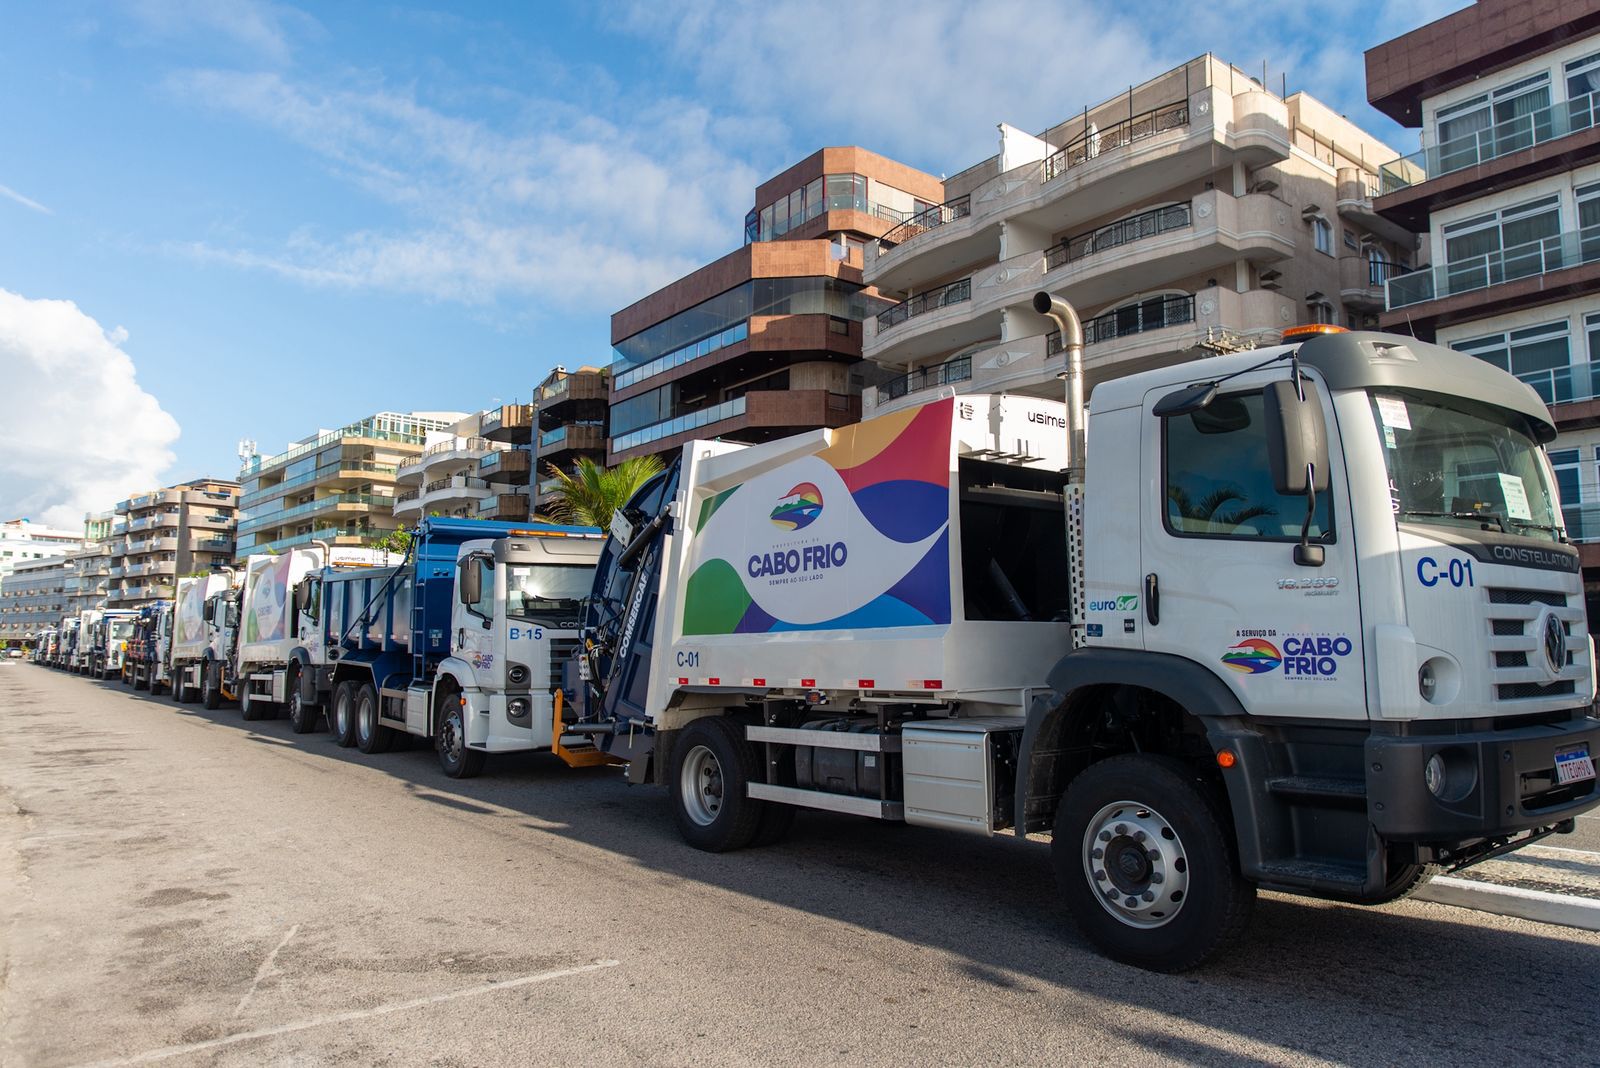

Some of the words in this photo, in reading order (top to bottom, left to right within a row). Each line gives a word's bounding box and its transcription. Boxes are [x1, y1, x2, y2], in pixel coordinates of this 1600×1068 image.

[1027, 411, 1066, 428] usime
[748, 549, 800, 578] CABO
[803, 541, 848, 571] FRIO
[1494, 546, 1573, 568] CONSTELLATION
[769, 578, 789, 586] SEMPRE
[809, 573, 824, 581] LADO
[1417, 557, 1475, 587] C-01
[620, 572, 649, 658] COMSERCAF
[509, 628, 542, 640] B-15
[1241, 629, 1267, 638] SERVIÇO
[1268, 629, 1277, 637] DA
[1283, 637, 1352, 656] CABO
[676, 651, 699, 667] C-01
[1284, 657, 1337, 675] FRIO
